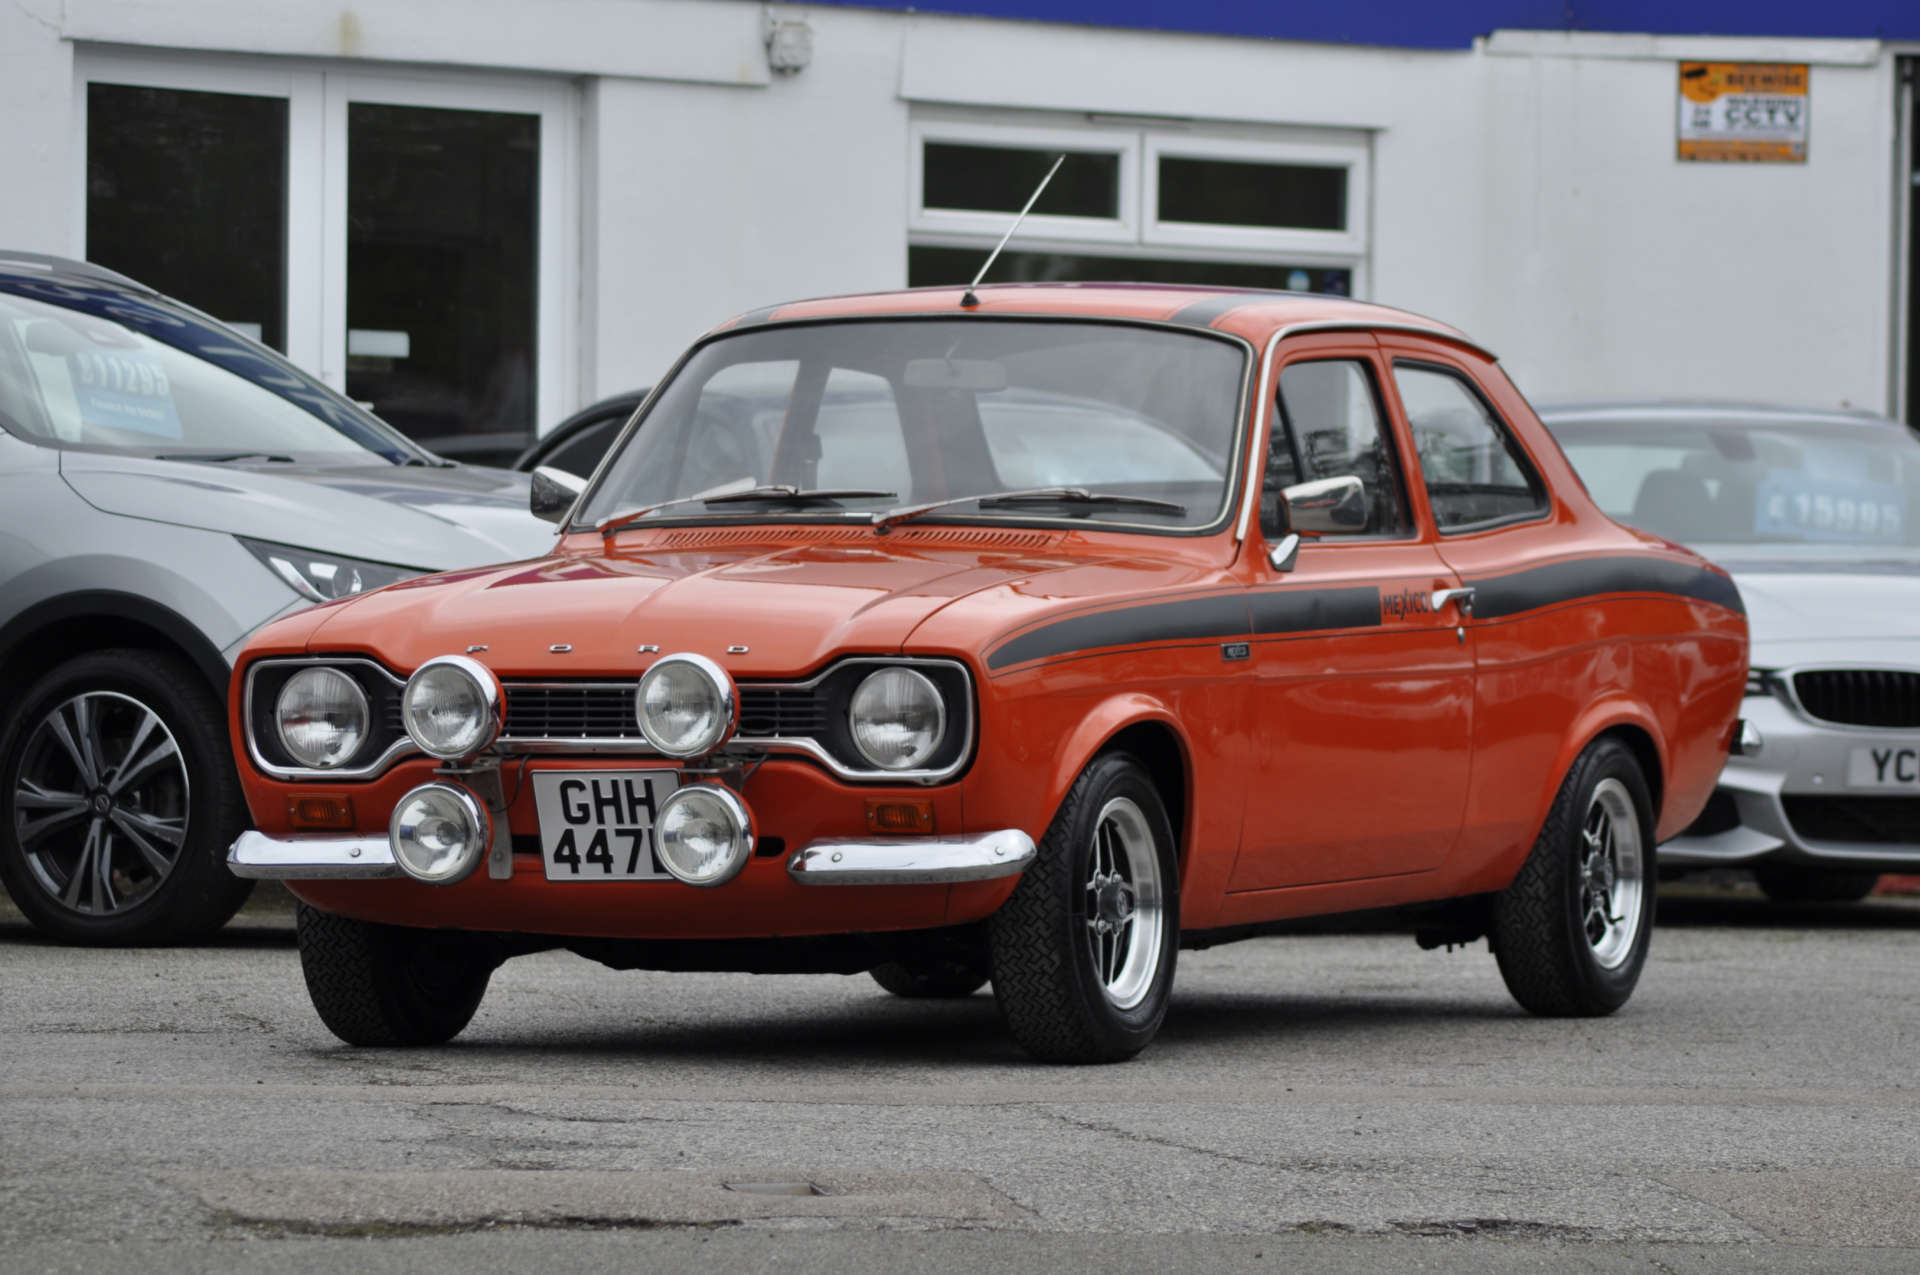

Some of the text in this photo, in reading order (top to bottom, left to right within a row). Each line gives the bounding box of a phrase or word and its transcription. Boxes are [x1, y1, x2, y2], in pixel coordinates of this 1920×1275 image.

[1725, 107, 1801, 124] CCTV
[1383, 587, 1429, 621] MEXICO
[466, 644, 749, 654] FORD
[1871, 749, 1920, 782] YC
[559, 778, 656, 825] GHH
